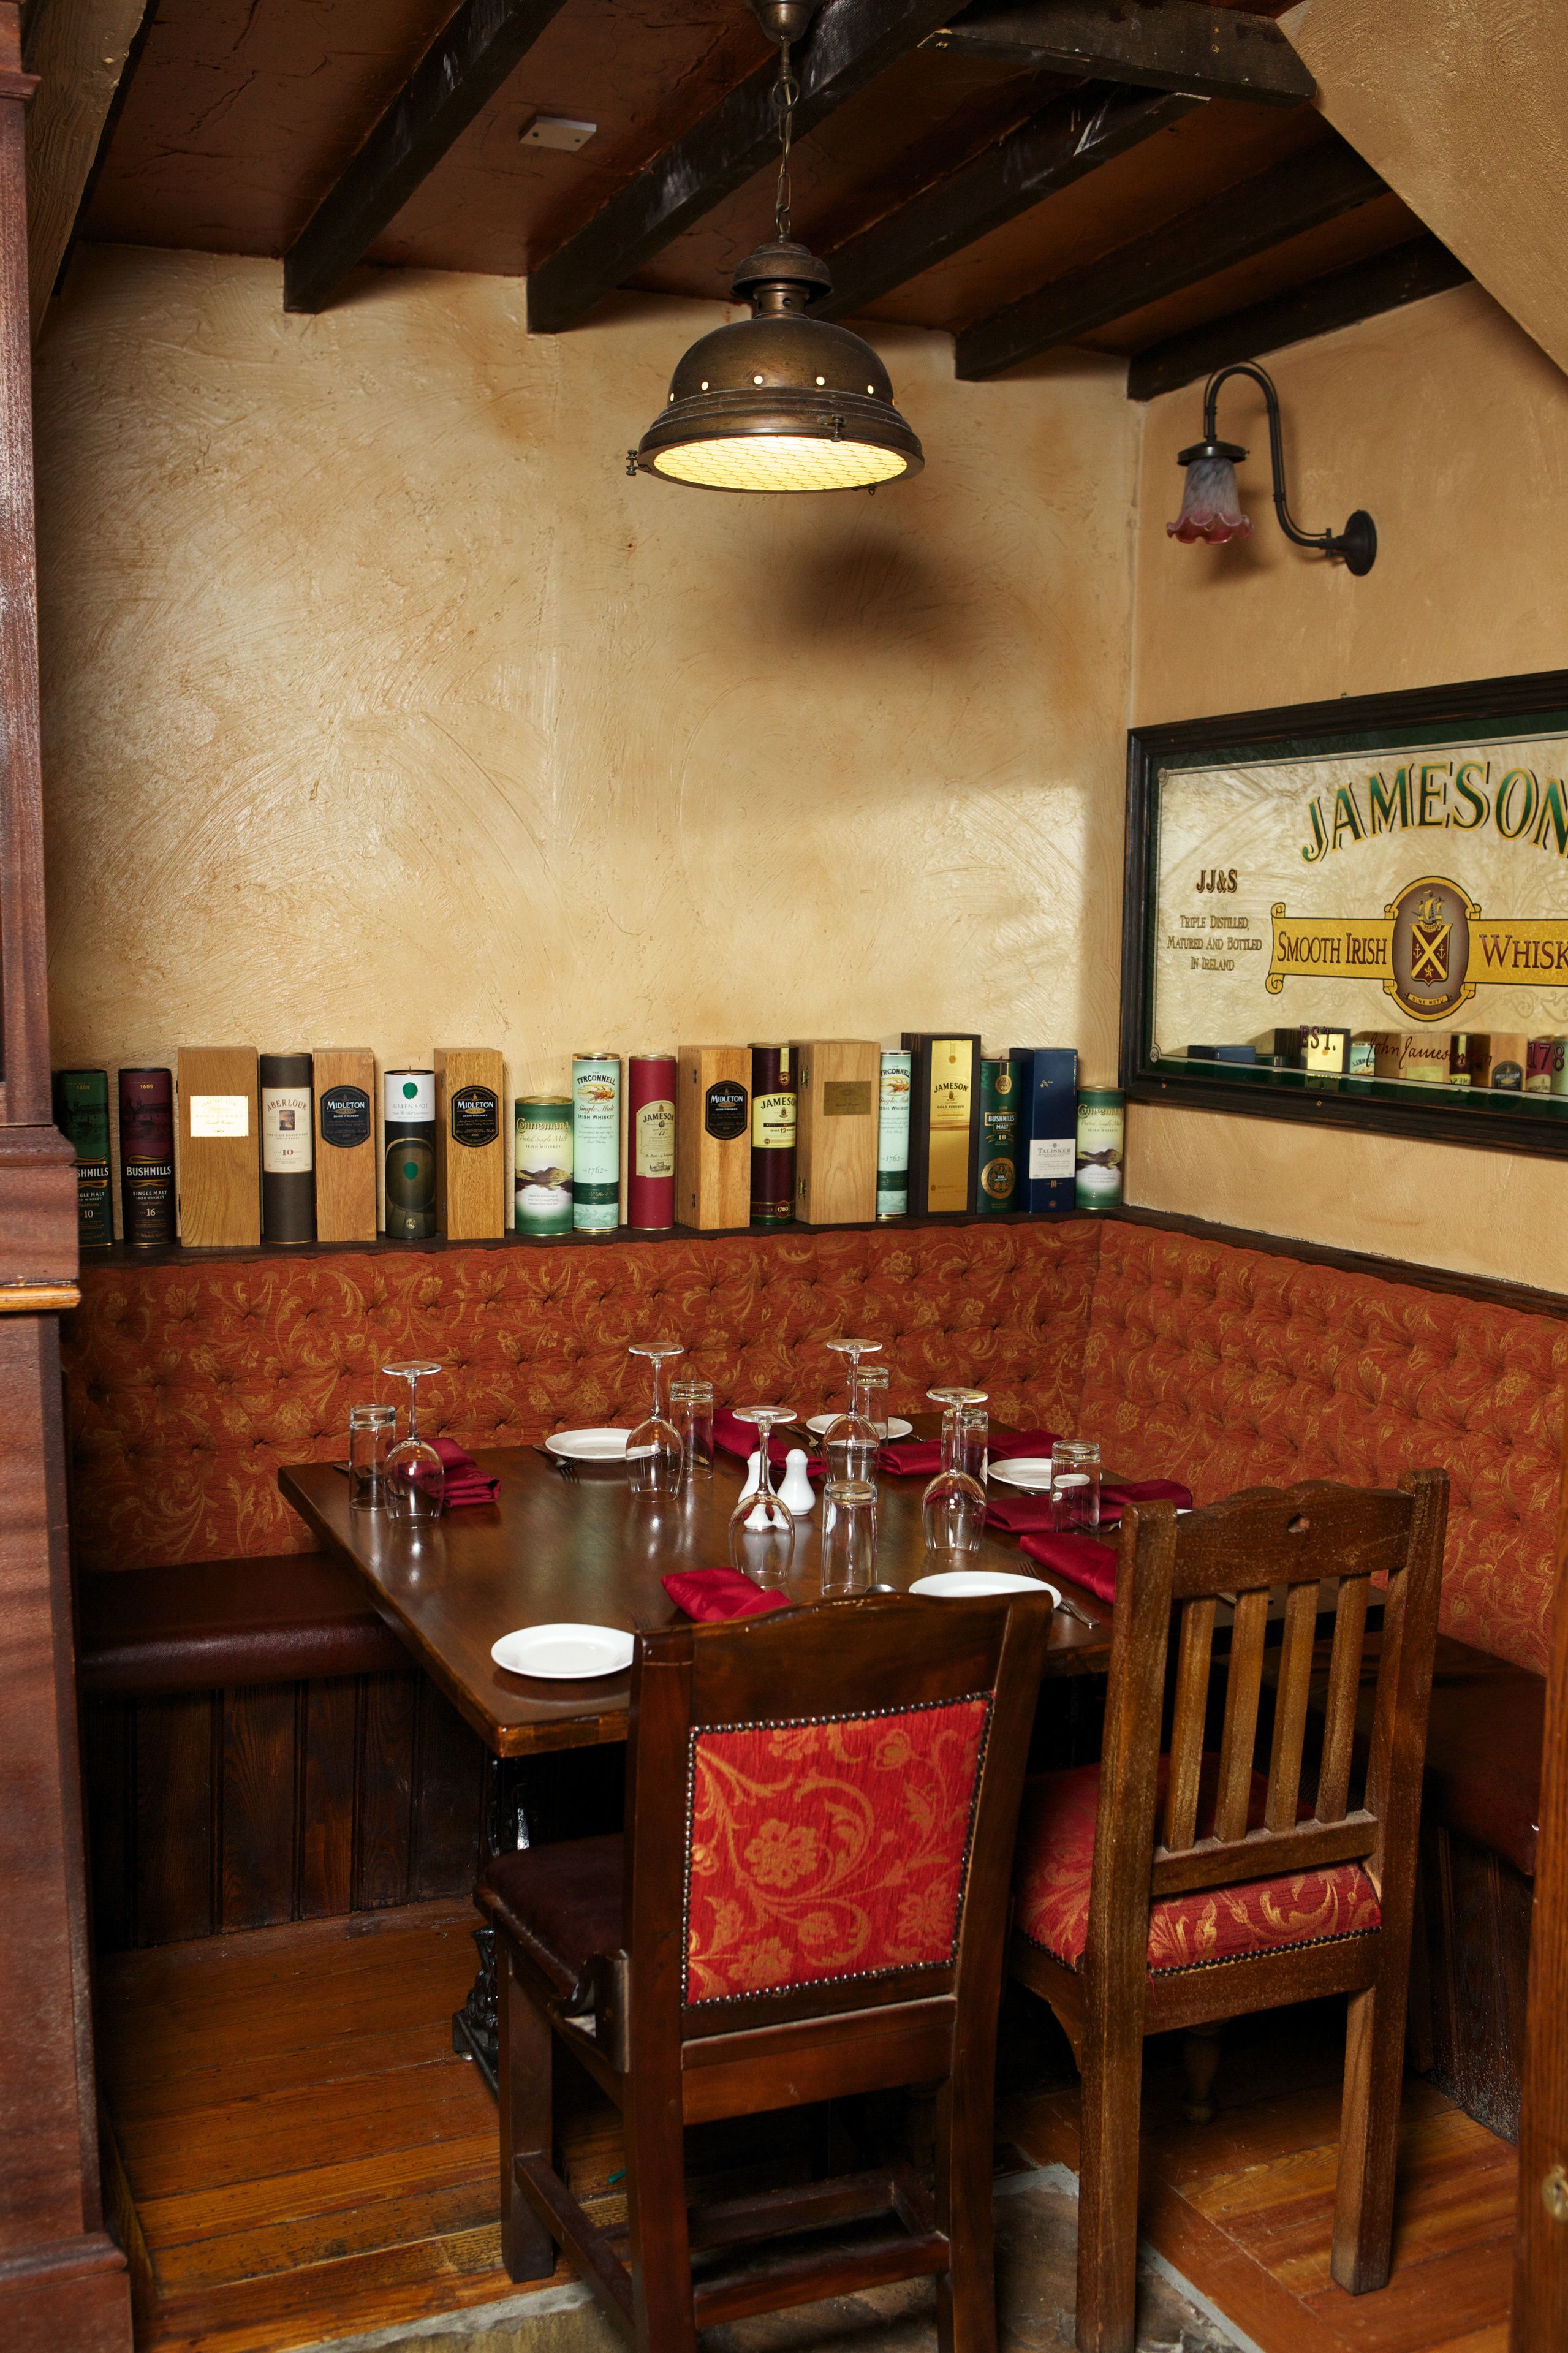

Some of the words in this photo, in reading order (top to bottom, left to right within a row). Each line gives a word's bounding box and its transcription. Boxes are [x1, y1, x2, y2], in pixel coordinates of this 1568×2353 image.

[1301, 760, 1568, 865] JAMESON
[1196, 868, 1238, 893] JJ&S
[1180, 915, 1206, 929] TRIPLE
[1167, 936, 1203, 950] MATURED
[1206, 937, 1224, 950] AND
[1227, 937, 1263, 950] BOTTLED
[1277, 930, 1342, 964] SMOOTH
[1346, 932, 1388, 965] IRISH
[1191, 957, 1199, 969] IN
[1202, 957, 1235, 971] IRELAND
[1412, 996, 1426, 1005] SINE
[1299, 1025, 1336, 1051] EST.
[1366, 1032, 1400, 1068] John
[577, 1075, 615, 1085] TYRCONNELL
[934, 1082, 968, 1093] JAMESON
[711, 1095, 743, 1104] MIDLETON
[267, 1099, 307, 1112] ABERLOUR
[327, 1101, 365, 1110] MIDLETON
[457, 1101, 494, 1110] MIDLETON
[578, 1104, 597, 1114] Single
[643, 1113, 674, 1123] JAMESON
[517, 1117, 570, 1133] Connemara
[885, 1153, 900, 1164] 1762
[126, 1166, 172, 1176] BUSHMILLS
[588, 1166, 604, 1175] 1762
[84, 1210, 93, 1218] 10
[146, 1208, 156, 1217] 16
